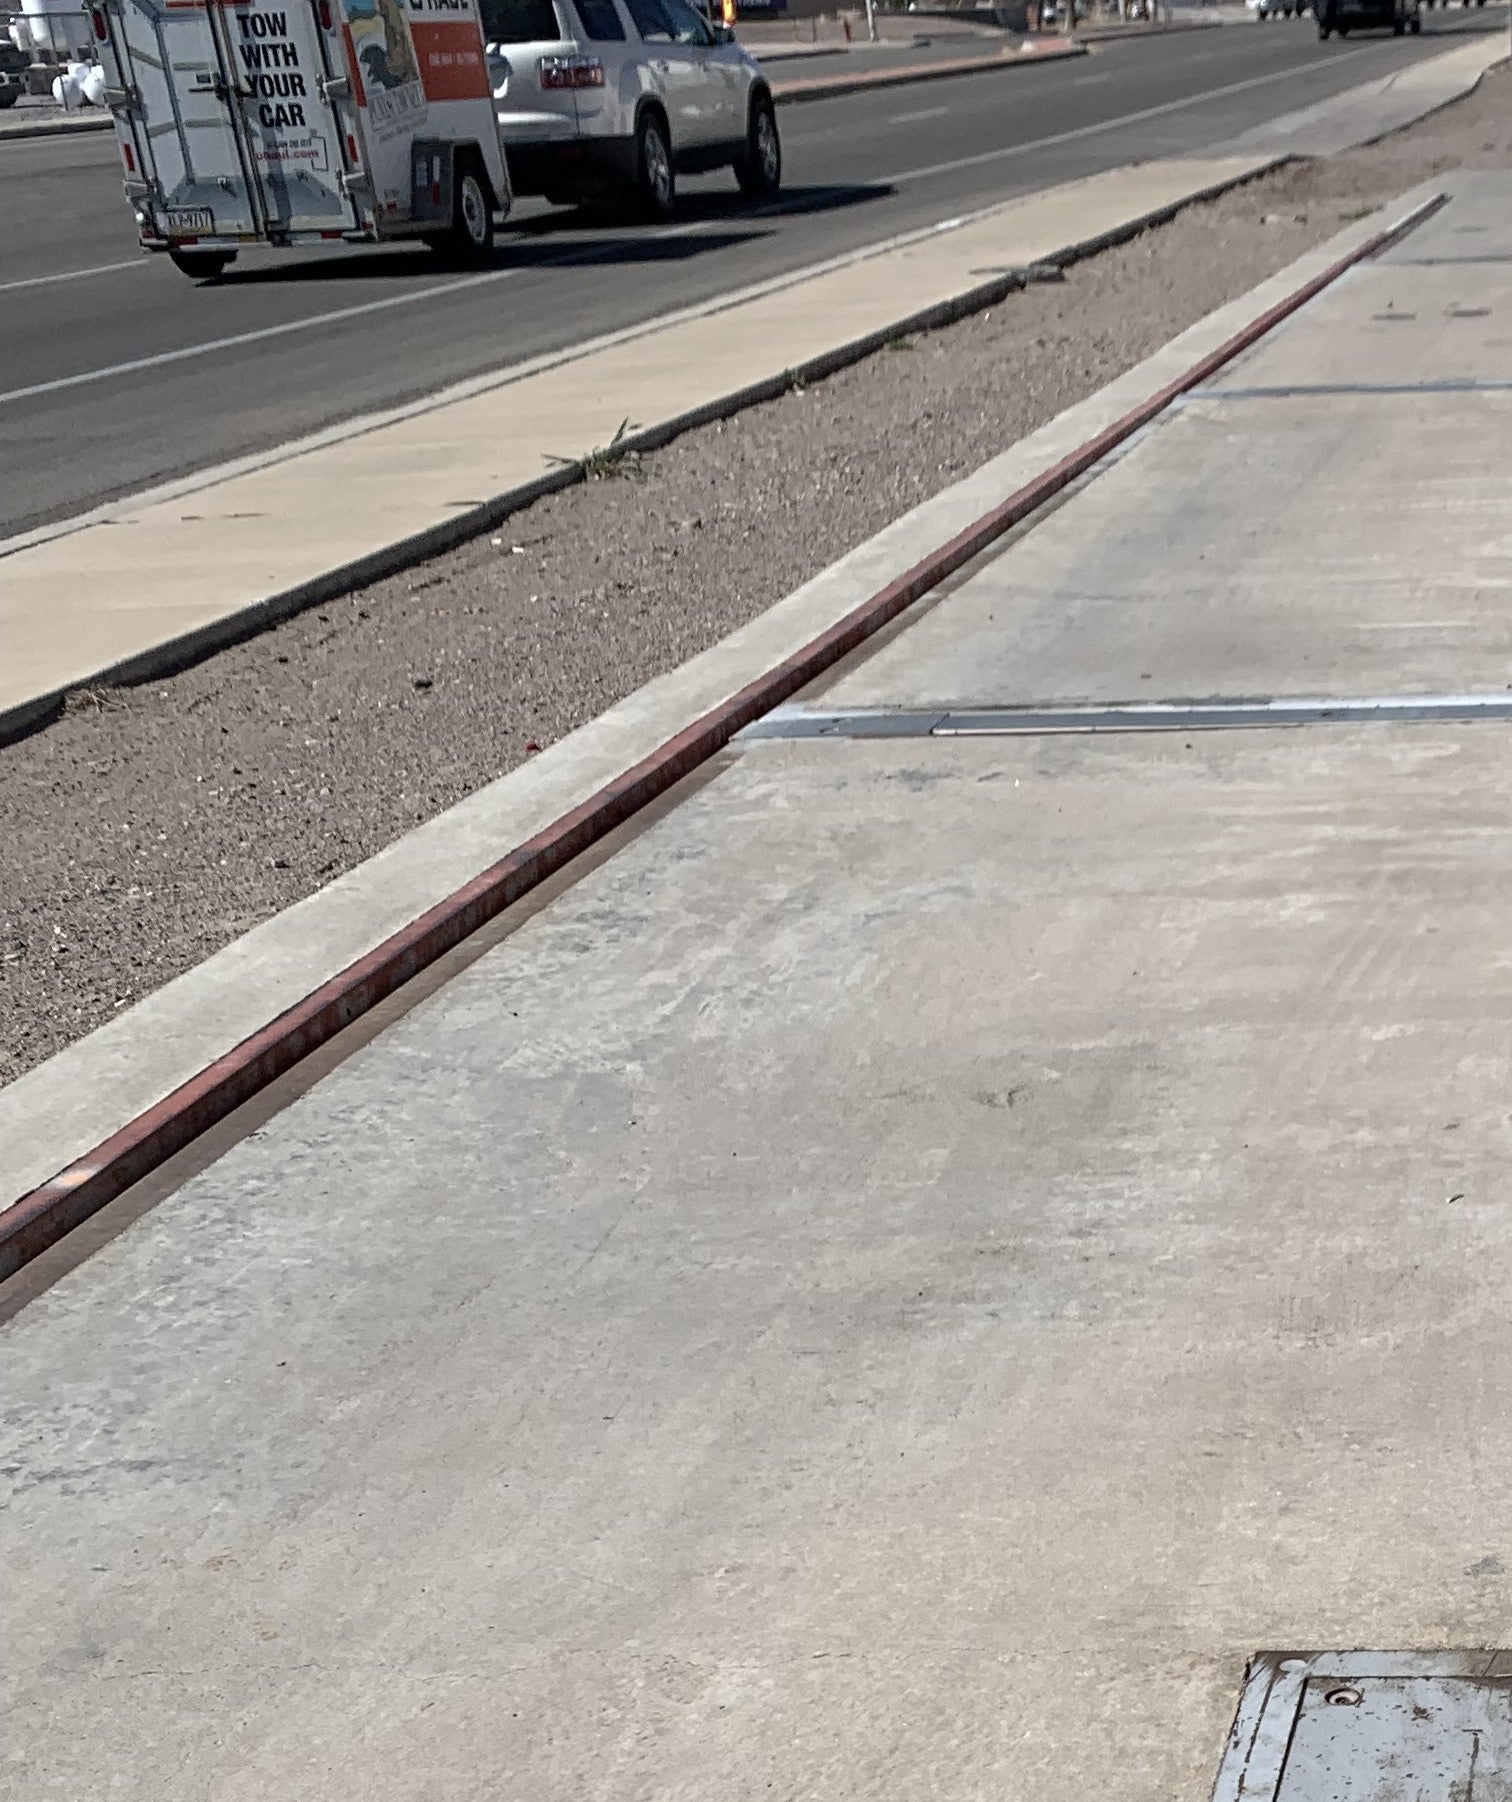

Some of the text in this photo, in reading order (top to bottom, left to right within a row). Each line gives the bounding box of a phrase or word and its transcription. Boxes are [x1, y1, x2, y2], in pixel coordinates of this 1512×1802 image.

[409, 0, 469, 10] UHAUL
[236, 11, 287, 38] TOW
[239, 42, 299, 68] WITH
[244, 72, 307, 99] YOUR
[259, 102, 306, 128] CAR
